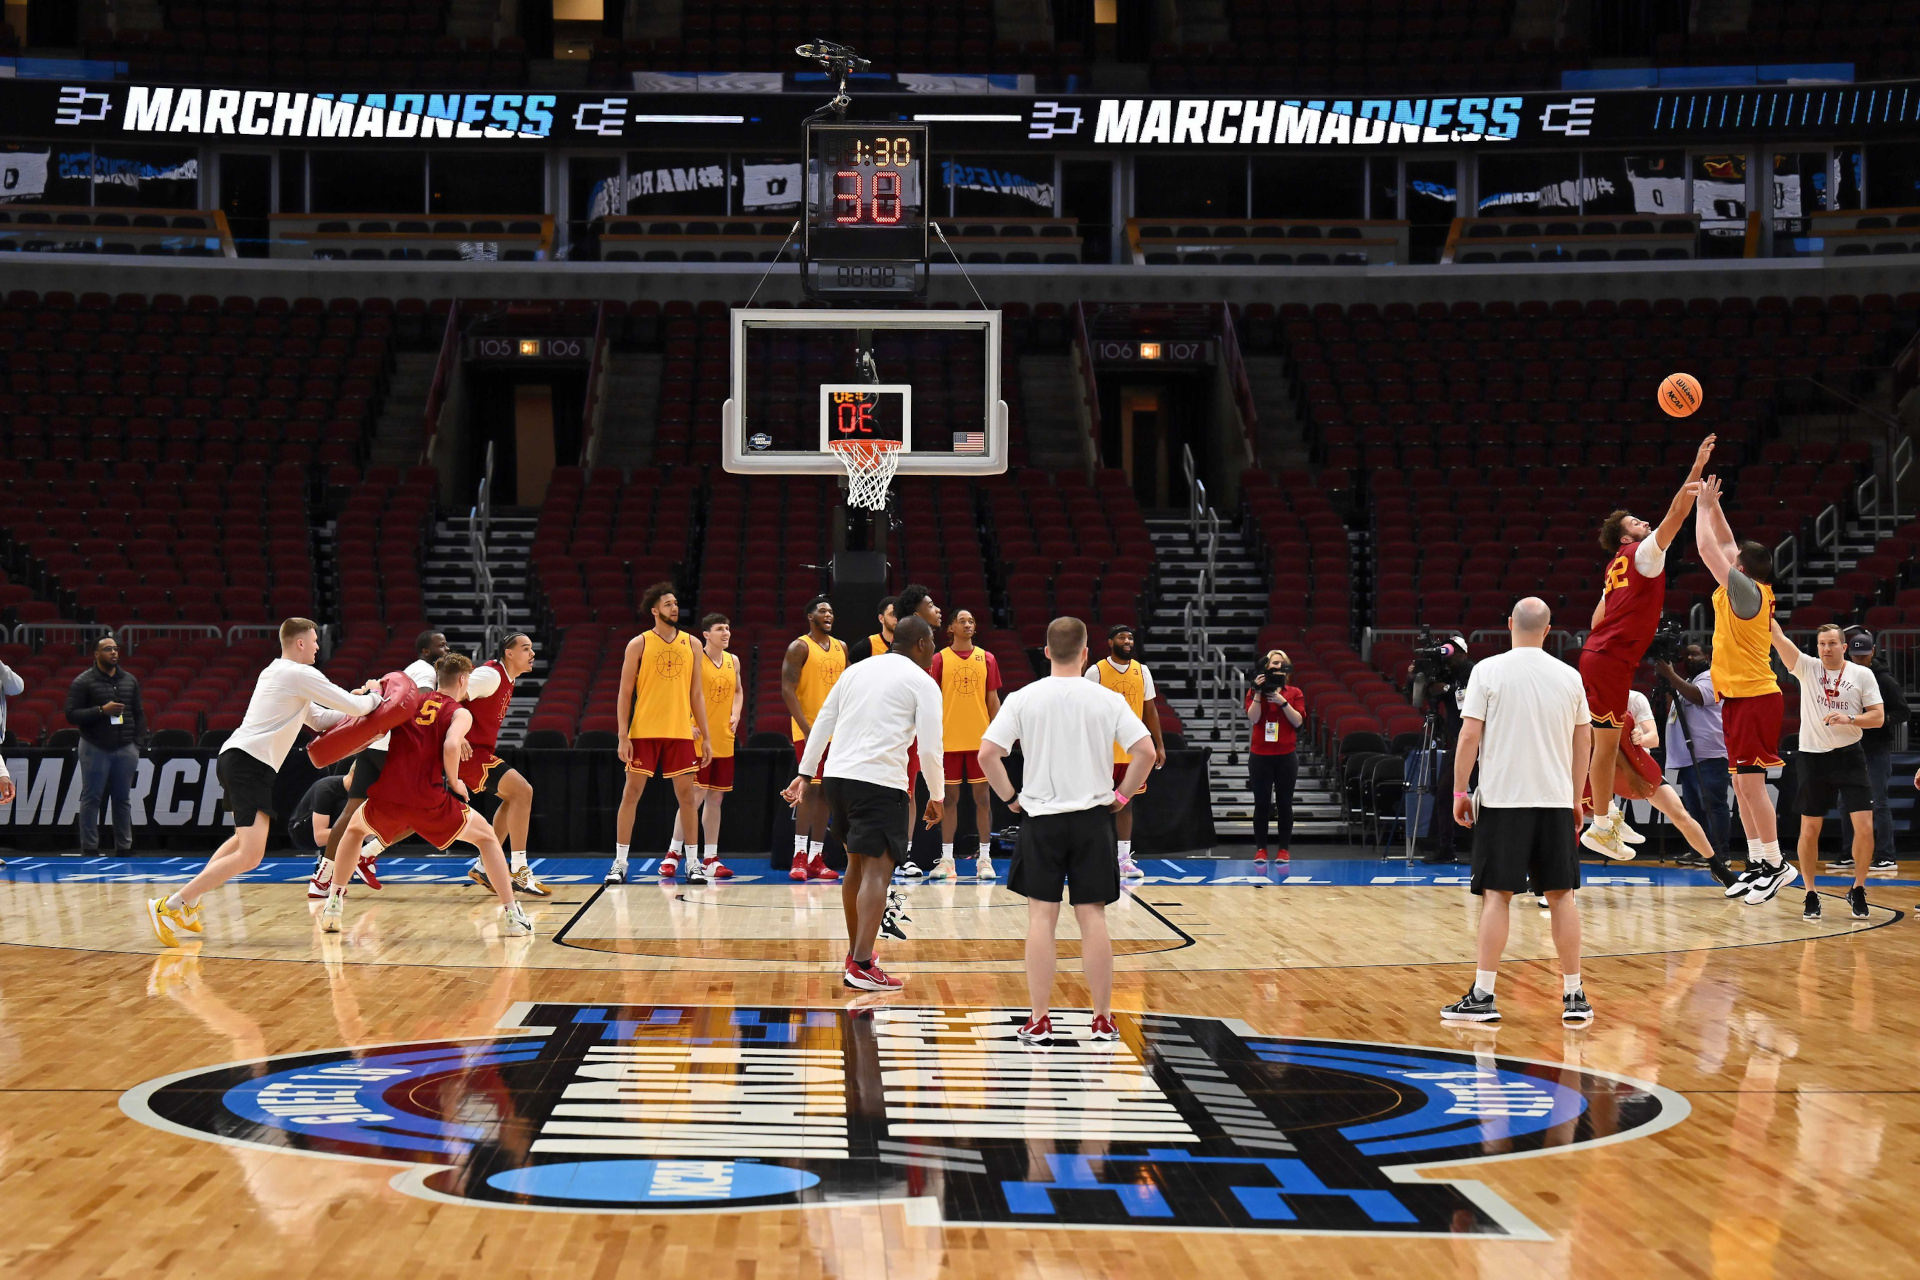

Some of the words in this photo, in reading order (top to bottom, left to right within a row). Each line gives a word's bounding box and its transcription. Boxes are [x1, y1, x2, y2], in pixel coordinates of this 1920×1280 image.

[855, 138, 911, 167] 1:30
[836, 171, 901, 223] 30
[480, 340, 511, 356] 105
[547, 340, 580, 356] 106
[1100, 343, 1133, 359] 106
[1169, 343, 1199, 359] 107
[975, 654, 984, 662] 21
[1833, 678, 1855, 691] SATE
[415, 699, 442, 726] 5
[1817, 695, 1849, 710] CYCONES
[283, 874, 593, 882] OD
[1370, 876, 1655, 884] FOR
[288, 1067, 413, 1081] 16
[256, 1082, 395, 1124] SWEET
[529, 1045, 848, 1158] MARCH
[1434, 1082, 1555, 1117] ELITE
[648, 1161, 737, 1196] NCAA
